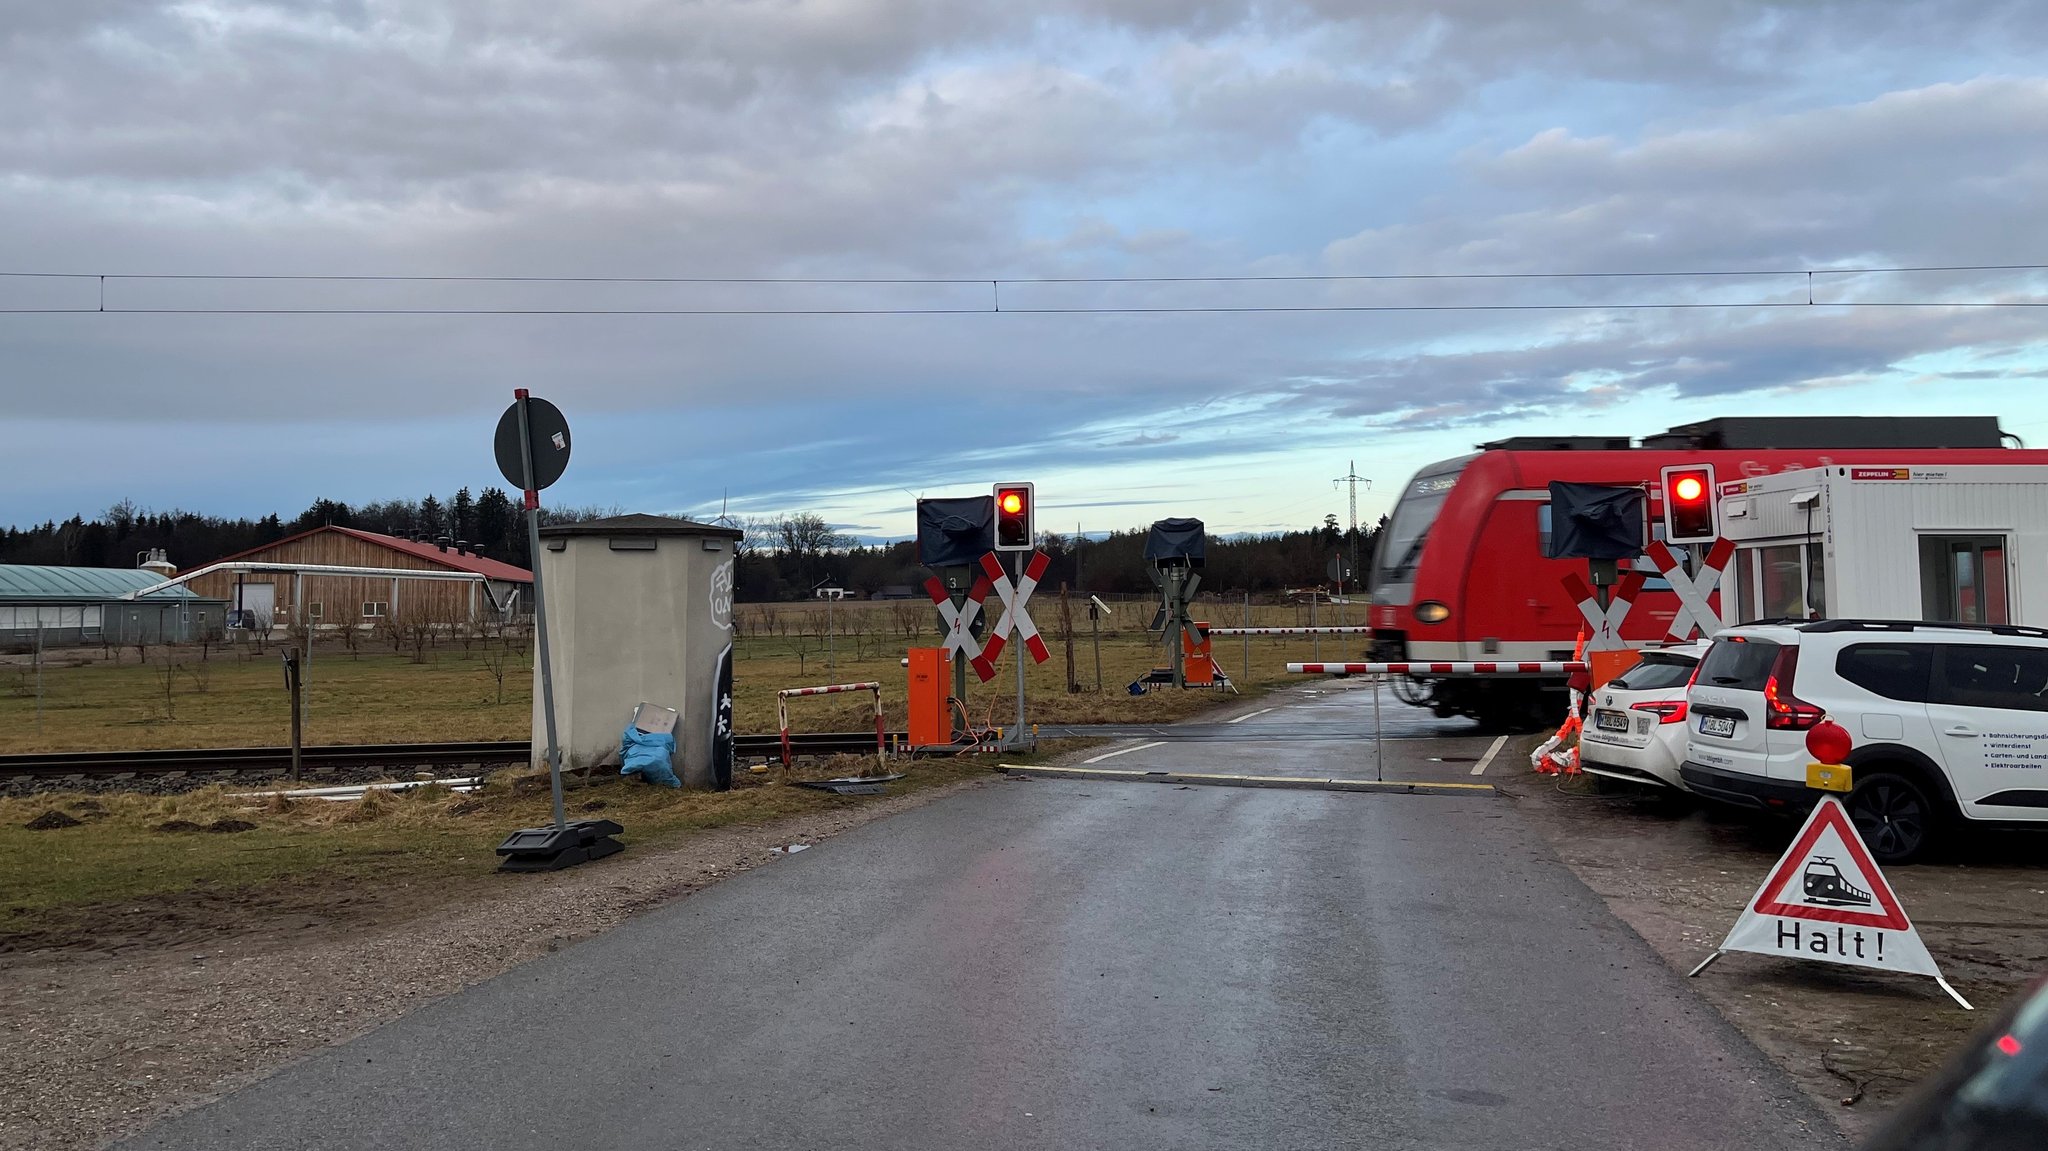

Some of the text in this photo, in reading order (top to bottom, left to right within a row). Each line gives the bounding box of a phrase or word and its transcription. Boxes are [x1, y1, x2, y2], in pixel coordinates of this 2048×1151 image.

[949, 577, 957, 589] 3
[1593, 571, 1599, 586] 1
[1777, 919, 1884, 962] Halt!
